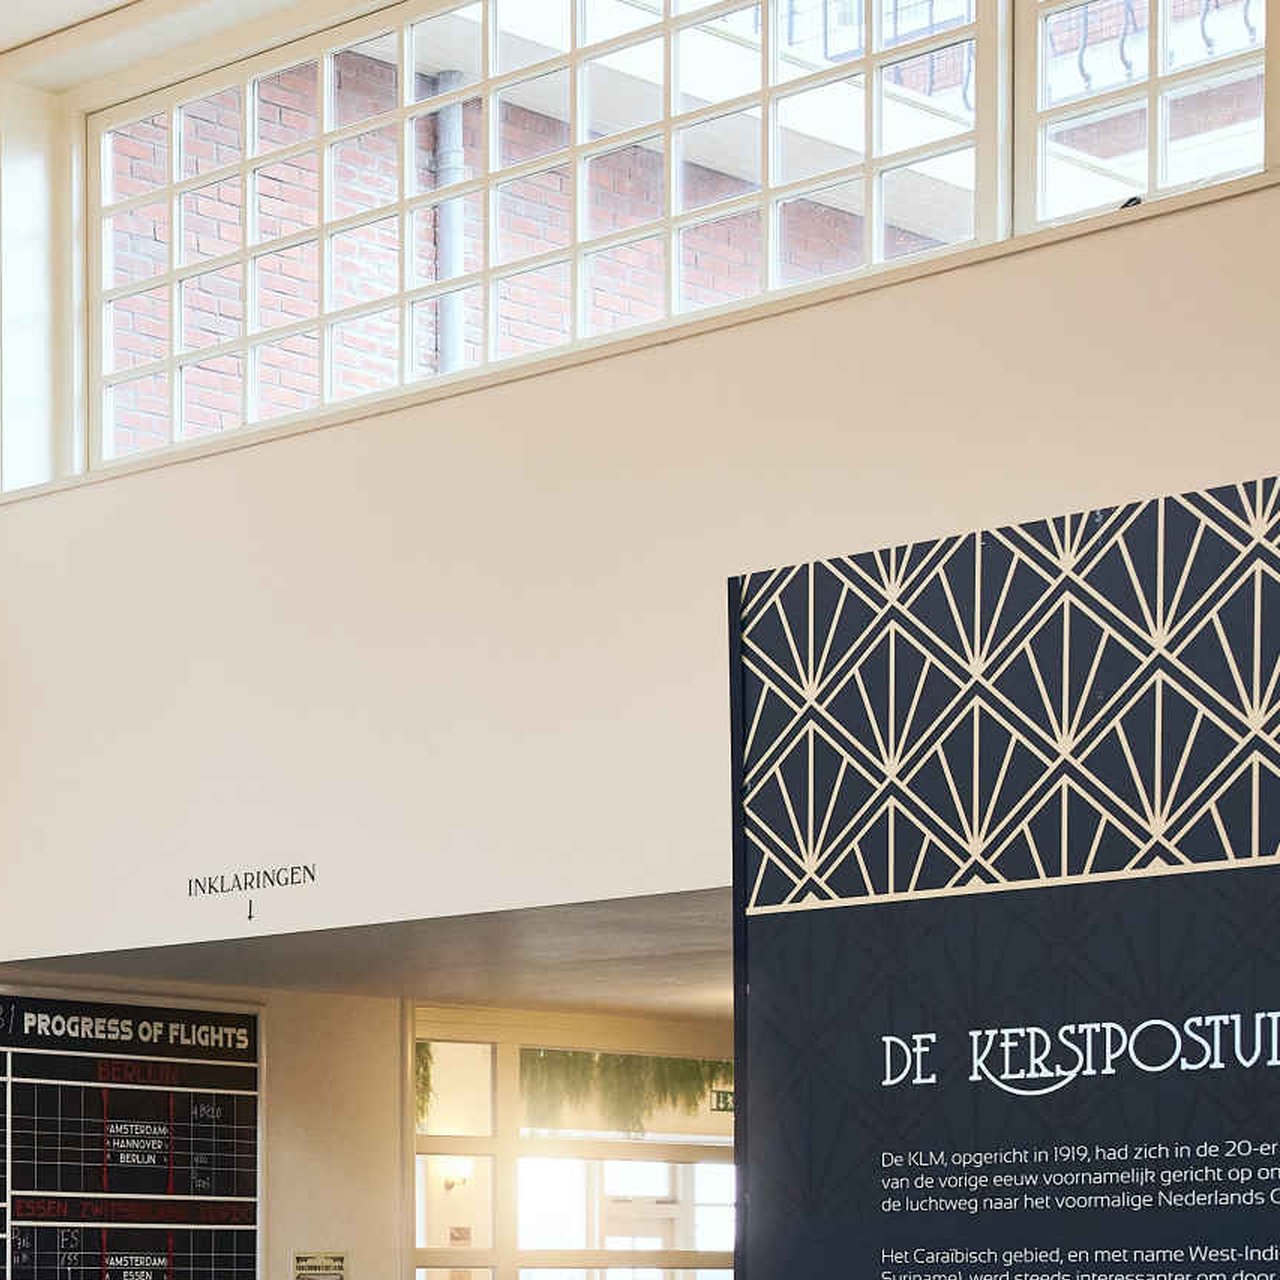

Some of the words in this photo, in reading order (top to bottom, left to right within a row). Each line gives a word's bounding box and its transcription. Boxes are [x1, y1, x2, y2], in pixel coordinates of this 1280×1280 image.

[188, 863, 317, 897] INKLARINGEN
[23, 1011, 133, 1041] PROGRESS
[137, 1020, 164, 1043] OF
[168, 1022, 249, 1049] FLIGHTS
[881, 1033, 938, 1087] DE
[112, 1138, 163, 1151] HANNOVER
[881, 1151, 904, 1168] De
[950, 1147, 1029, 1168] opgericht
[1033, 1150, 1049, 1163] in
[1094, 1143, 1129, 1161] had
[1133, 1142, 1169, 1160] zich
[1174, 1141, 1191, 1158] in
[1195, 1141, 1219, 1158] de
[881, 1196, 901, 1212] de
[905, 1195, 978, 1214] luchtweg
[982, 1196, 1020, 1210] naar
[1023, 1193, 1051, 1209] het
[1054, 1191, 1153, 1211] voormalige
[1157, 1188, 1265, 1207] Nederlands
